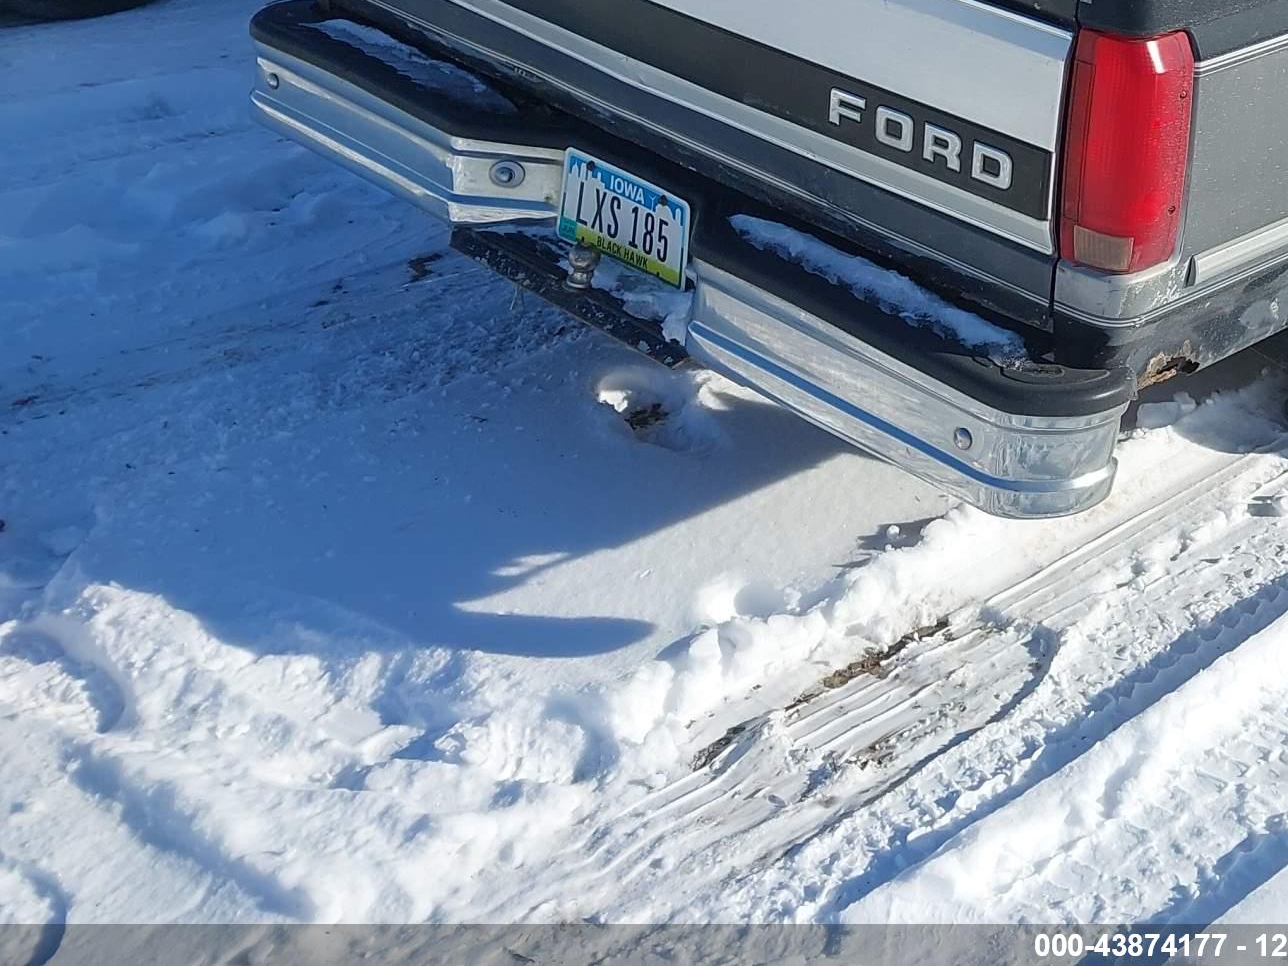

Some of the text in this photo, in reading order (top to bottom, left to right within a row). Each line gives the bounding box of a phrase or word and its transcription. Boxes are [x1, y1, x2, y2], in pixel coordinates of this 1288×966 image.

[828, 87, 1013, 190] FORD
[609, 175, 645, 205] IOWA
[576, 181, 669, 263] LXS 185
[596, 236, 648, 269] BLACK HAWK
